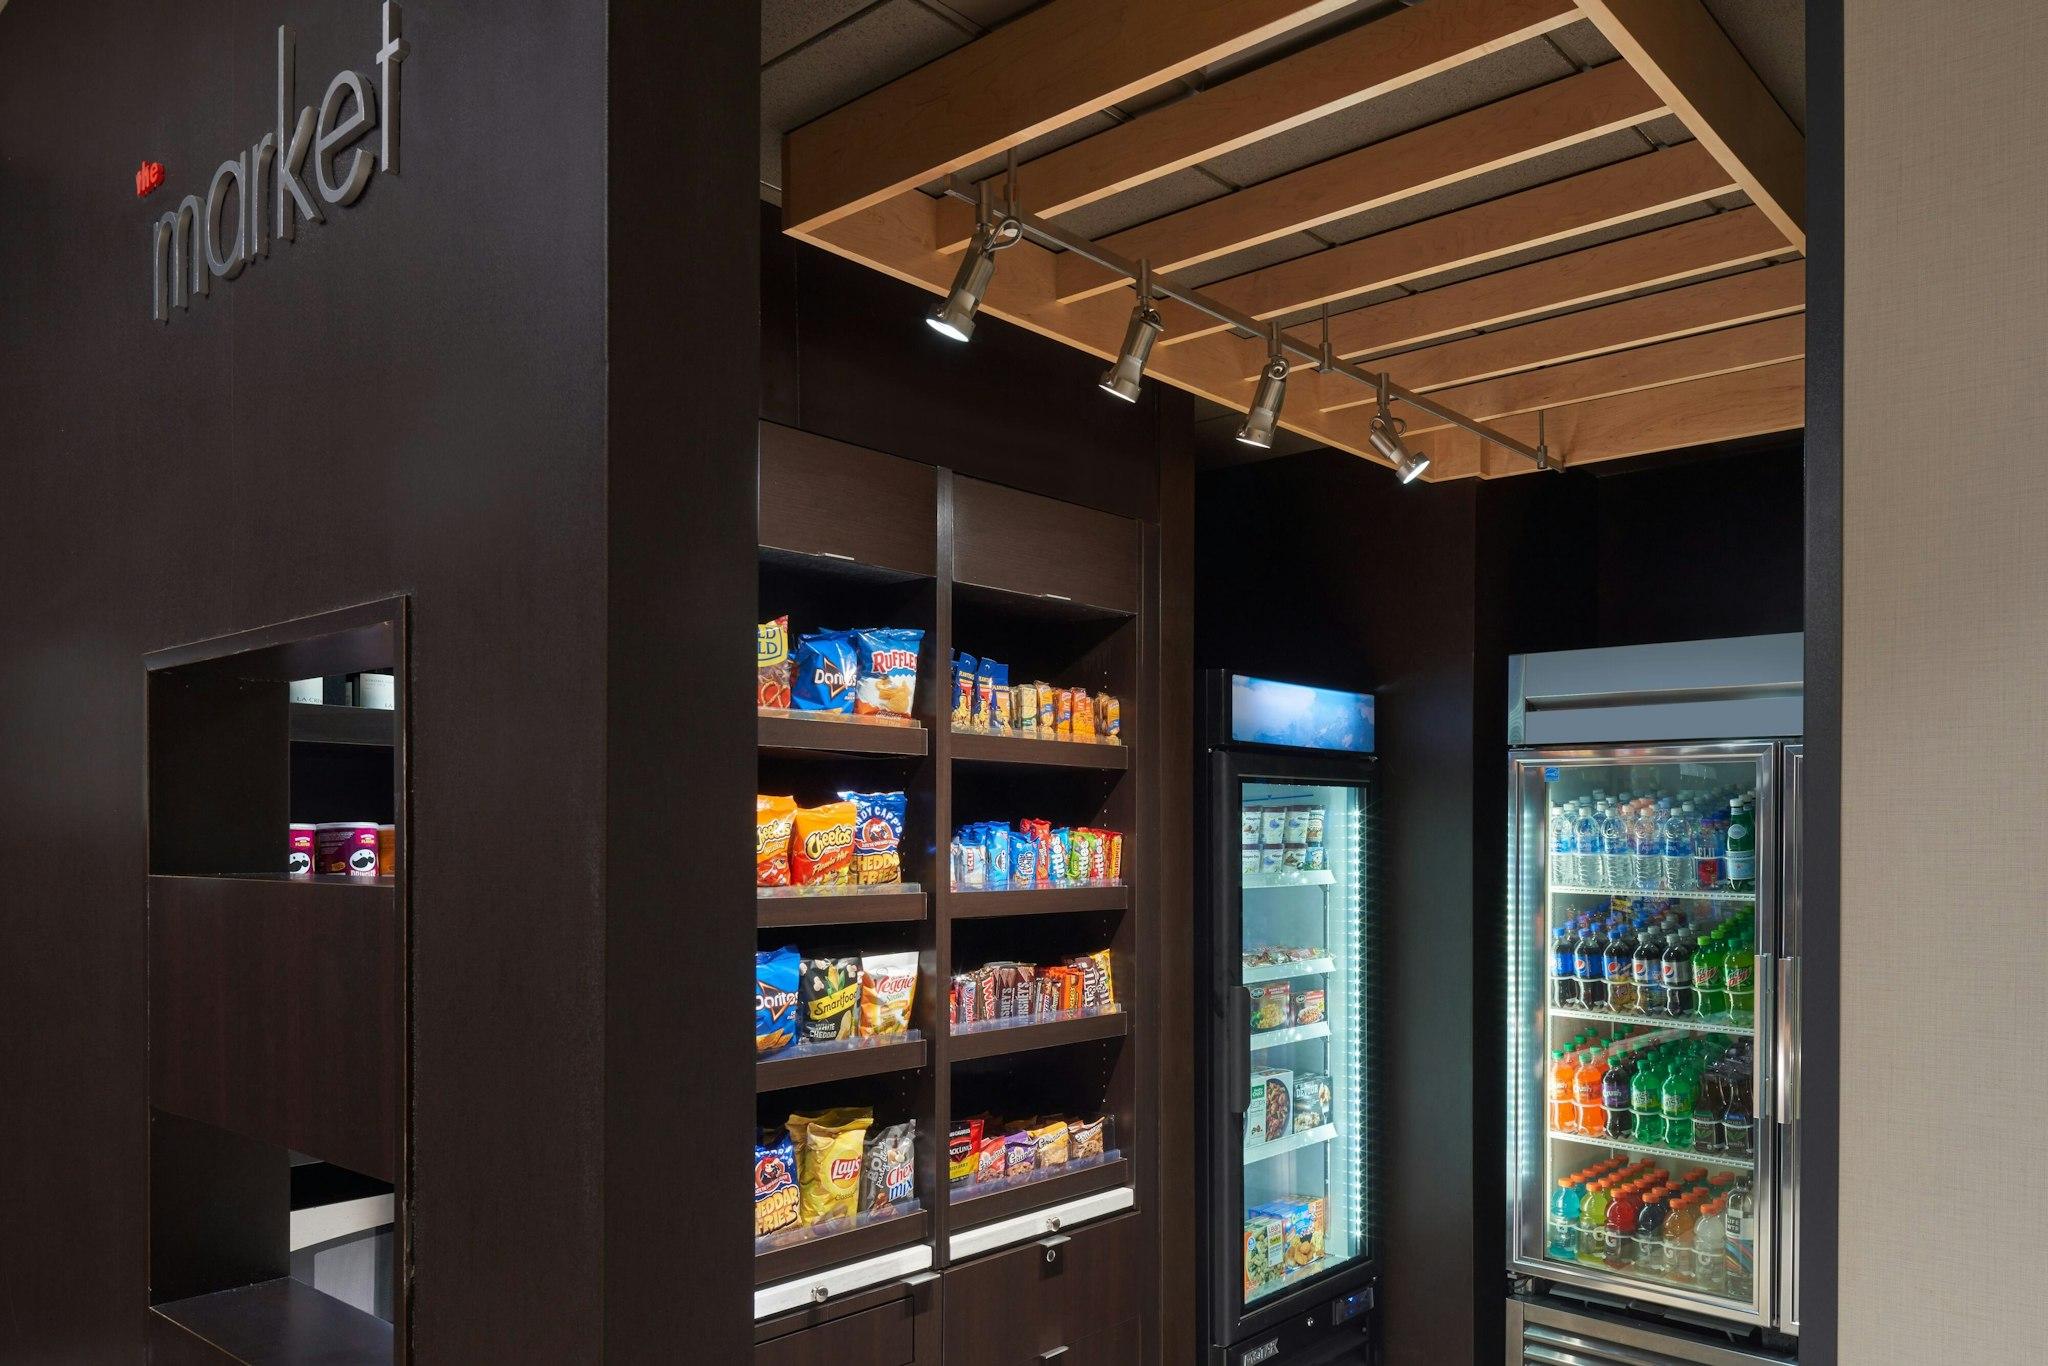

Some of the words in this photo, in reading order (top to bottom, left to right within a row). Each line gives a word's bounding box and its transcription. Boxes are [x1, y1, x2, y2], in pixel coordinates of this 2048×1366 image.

[153, 0, 411, 324] market
[136, 160, 166, 197] the
[756, 627, 777, 638] LD
[756, 641, 778, 655] LD
[756, 821, 791, 852] heetos
[806, 826, 853, 860] Cheetos
[875, 975, 916, 994] Veggie
[832, 1155, 863, 1182] Lay's
[886, 1162, 915, 1187] Chex
